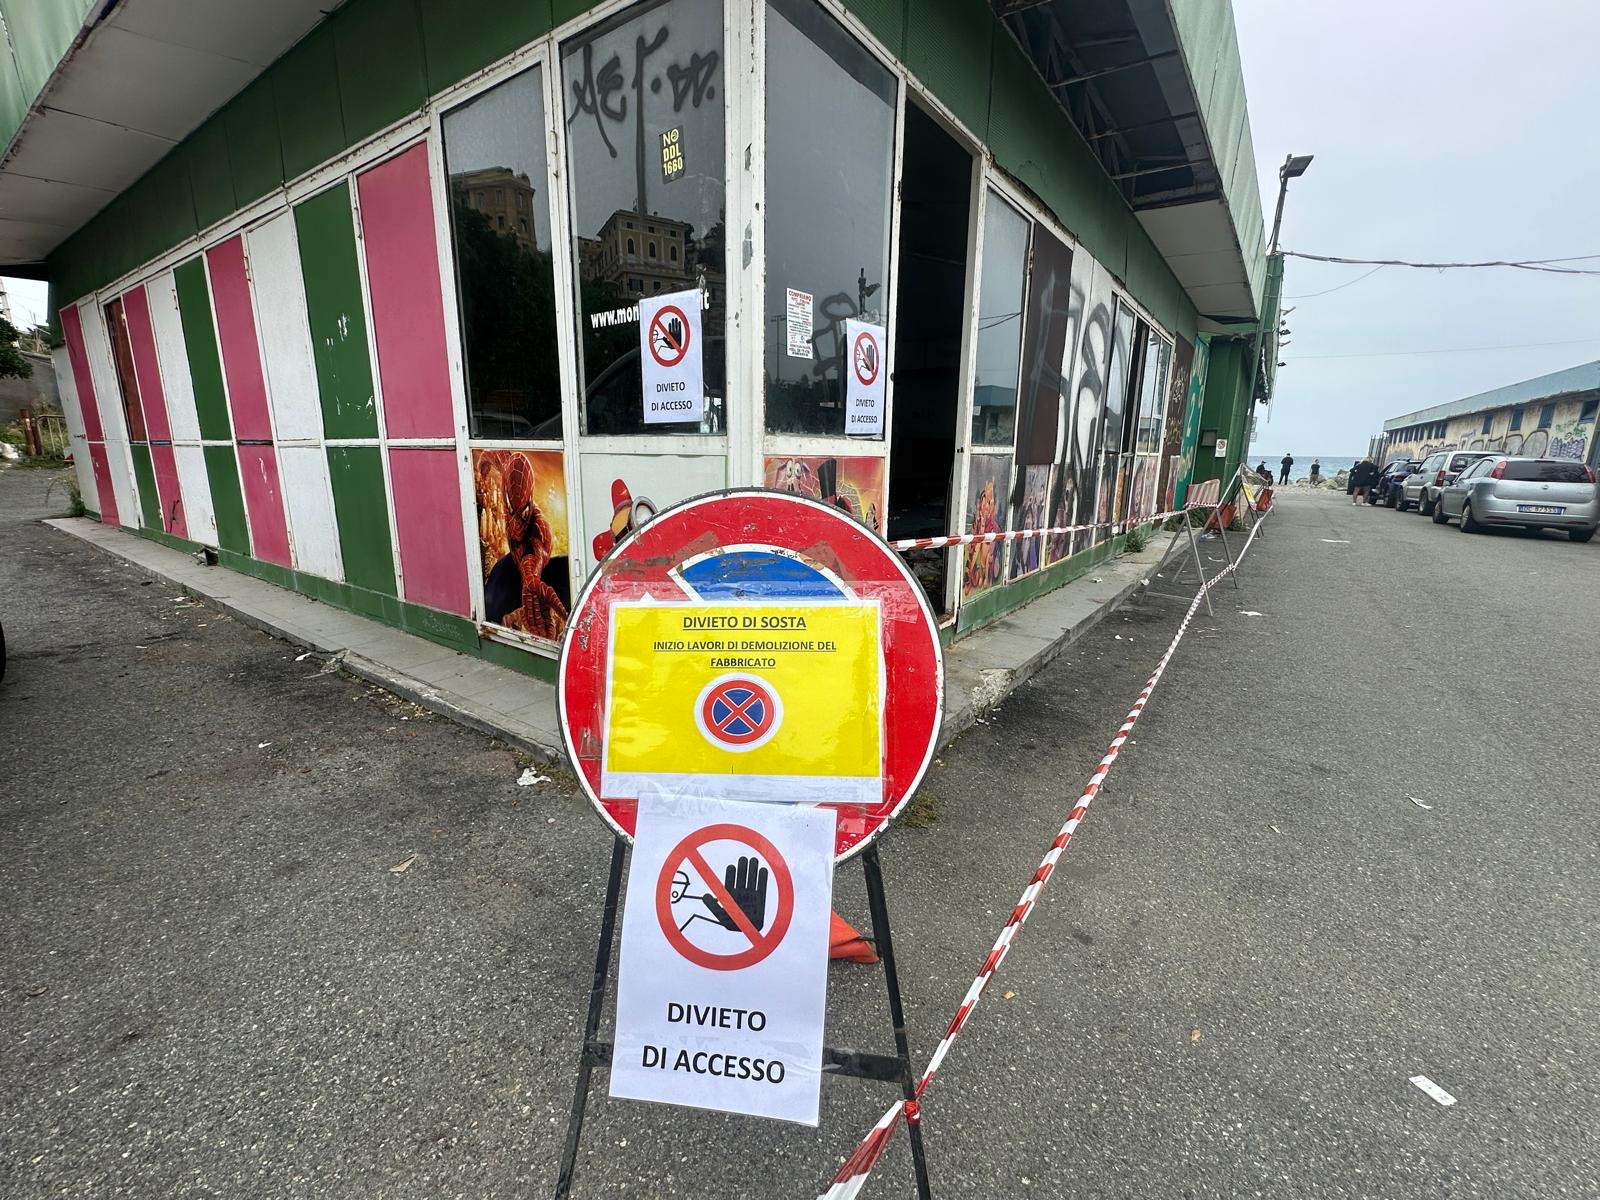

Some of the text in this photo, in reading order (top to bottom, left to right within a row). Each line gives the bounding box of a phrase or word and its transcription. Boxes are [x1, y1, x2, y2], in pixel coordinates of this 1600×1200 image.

[662, 128, 679, 147] NO
[663, 142, 681, 162] DDL
[663, 156, 683, 176] 1660
[656, 382, 686, 393] DIVIETO
[651, 400, 693, 411] DI ACCESSO
[855, 398, 875, 408] DIVIETO
[851, 415, 877, 424] DI ACCESSO
[683, 616, 806, 629] DIVIETO DI SOSTA
[653, 641, 836, 651] INIZIO LAVORI DI DEMOLIZIONE DEL
[710, 657, 776, 668] FABBRICATO
[667, 1002, 766, 1031] DIVIETO
[642, 1045, 785, 1083] DI ACCESSO
